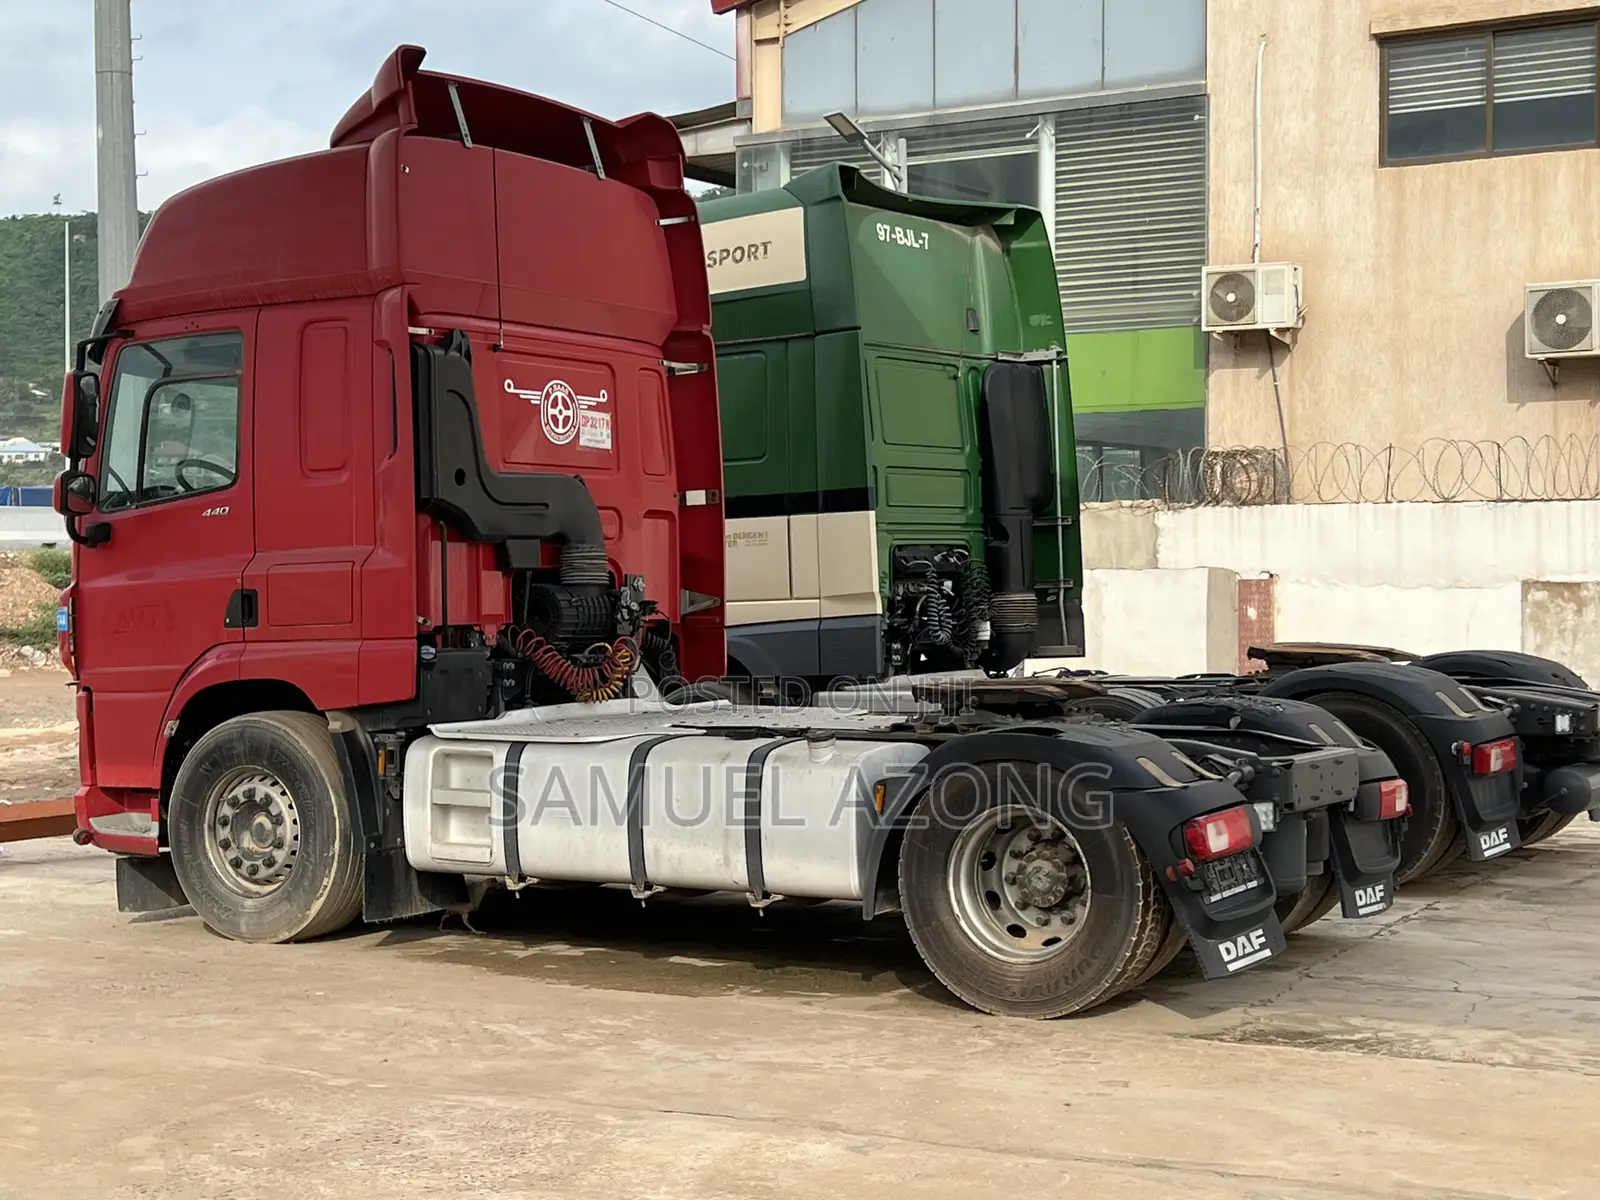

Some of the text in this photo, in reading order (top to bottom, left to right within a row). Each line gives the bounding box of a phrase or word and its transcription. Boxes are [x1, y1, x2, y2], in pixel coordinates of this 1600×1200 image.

[876, 222, 930, 251] 97-BJL-7
[706, 240, 773, 269] SPORT
[201, 506, 230, 517] 440
[1480, 828, 1508, 851] DAF
[1354, 884, 1385, 907] DAF
[1217, 928, 1267, 963] DAF
